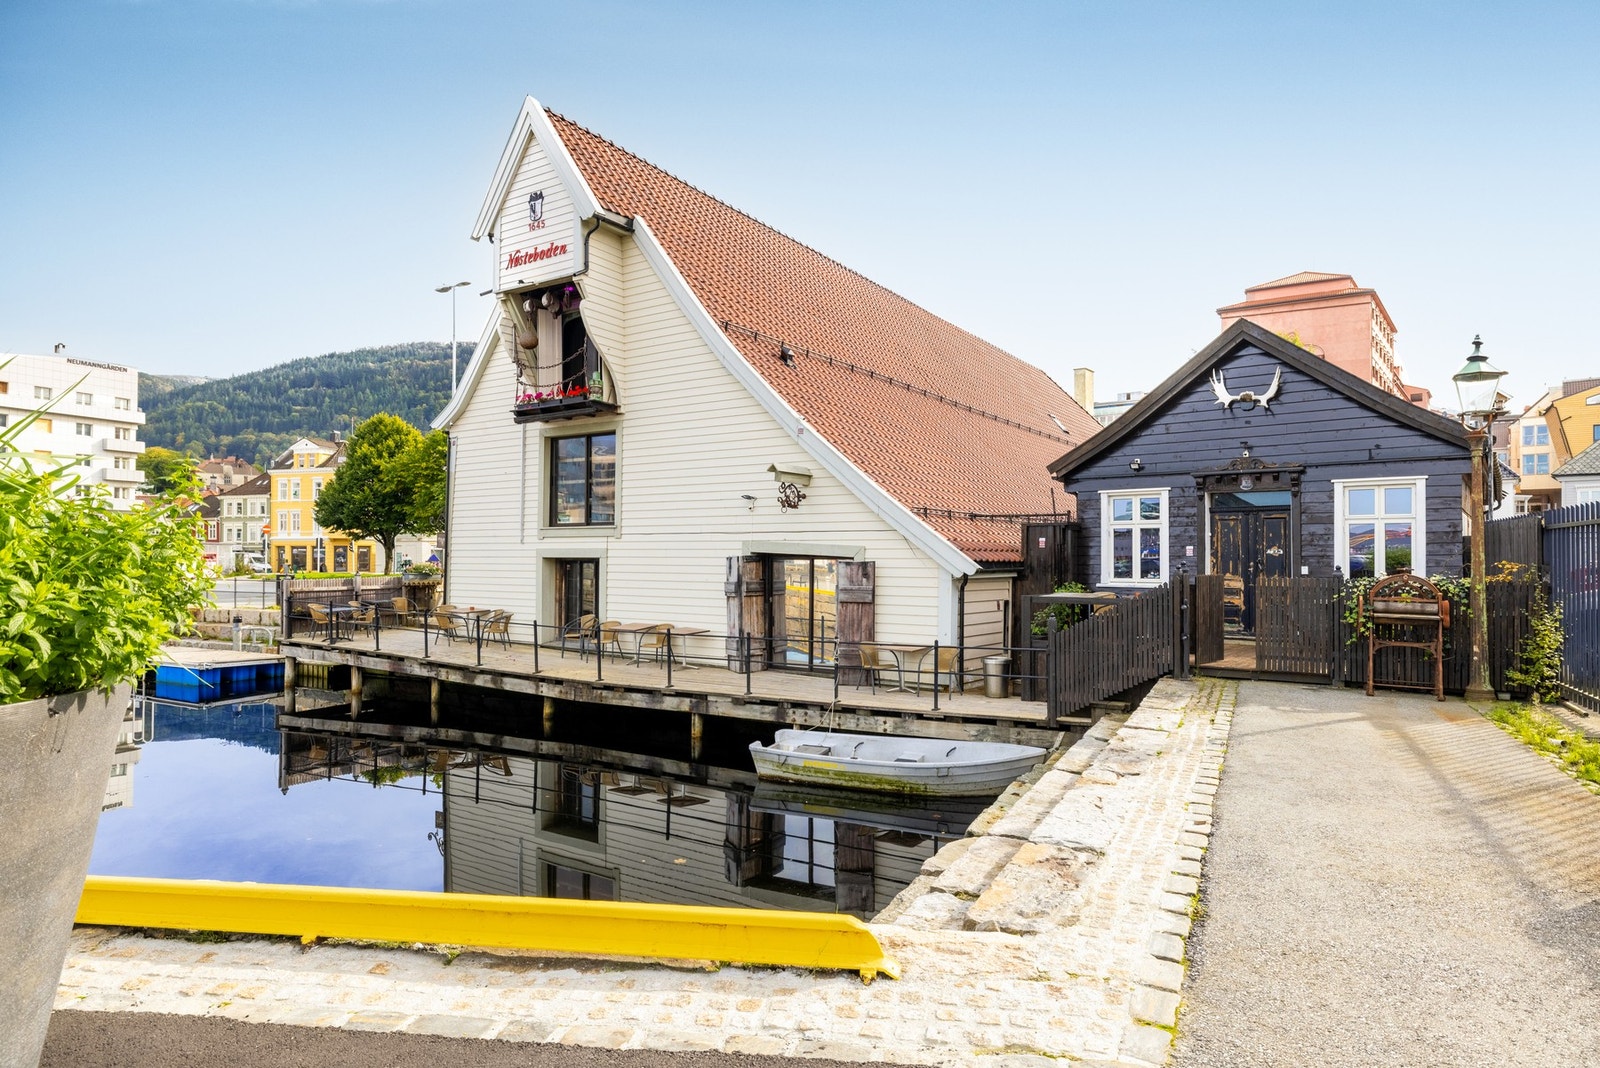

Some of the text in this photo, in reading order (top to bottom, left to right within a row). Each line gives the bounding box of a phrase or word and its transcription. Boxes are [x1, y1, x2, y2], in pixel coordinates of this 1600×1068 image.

[528, 220, 545, 232] 1645
[505, 242, 568, 270] Nøsteboden
[66, 358, 128, 373] NEUMANNGÅRDEN
